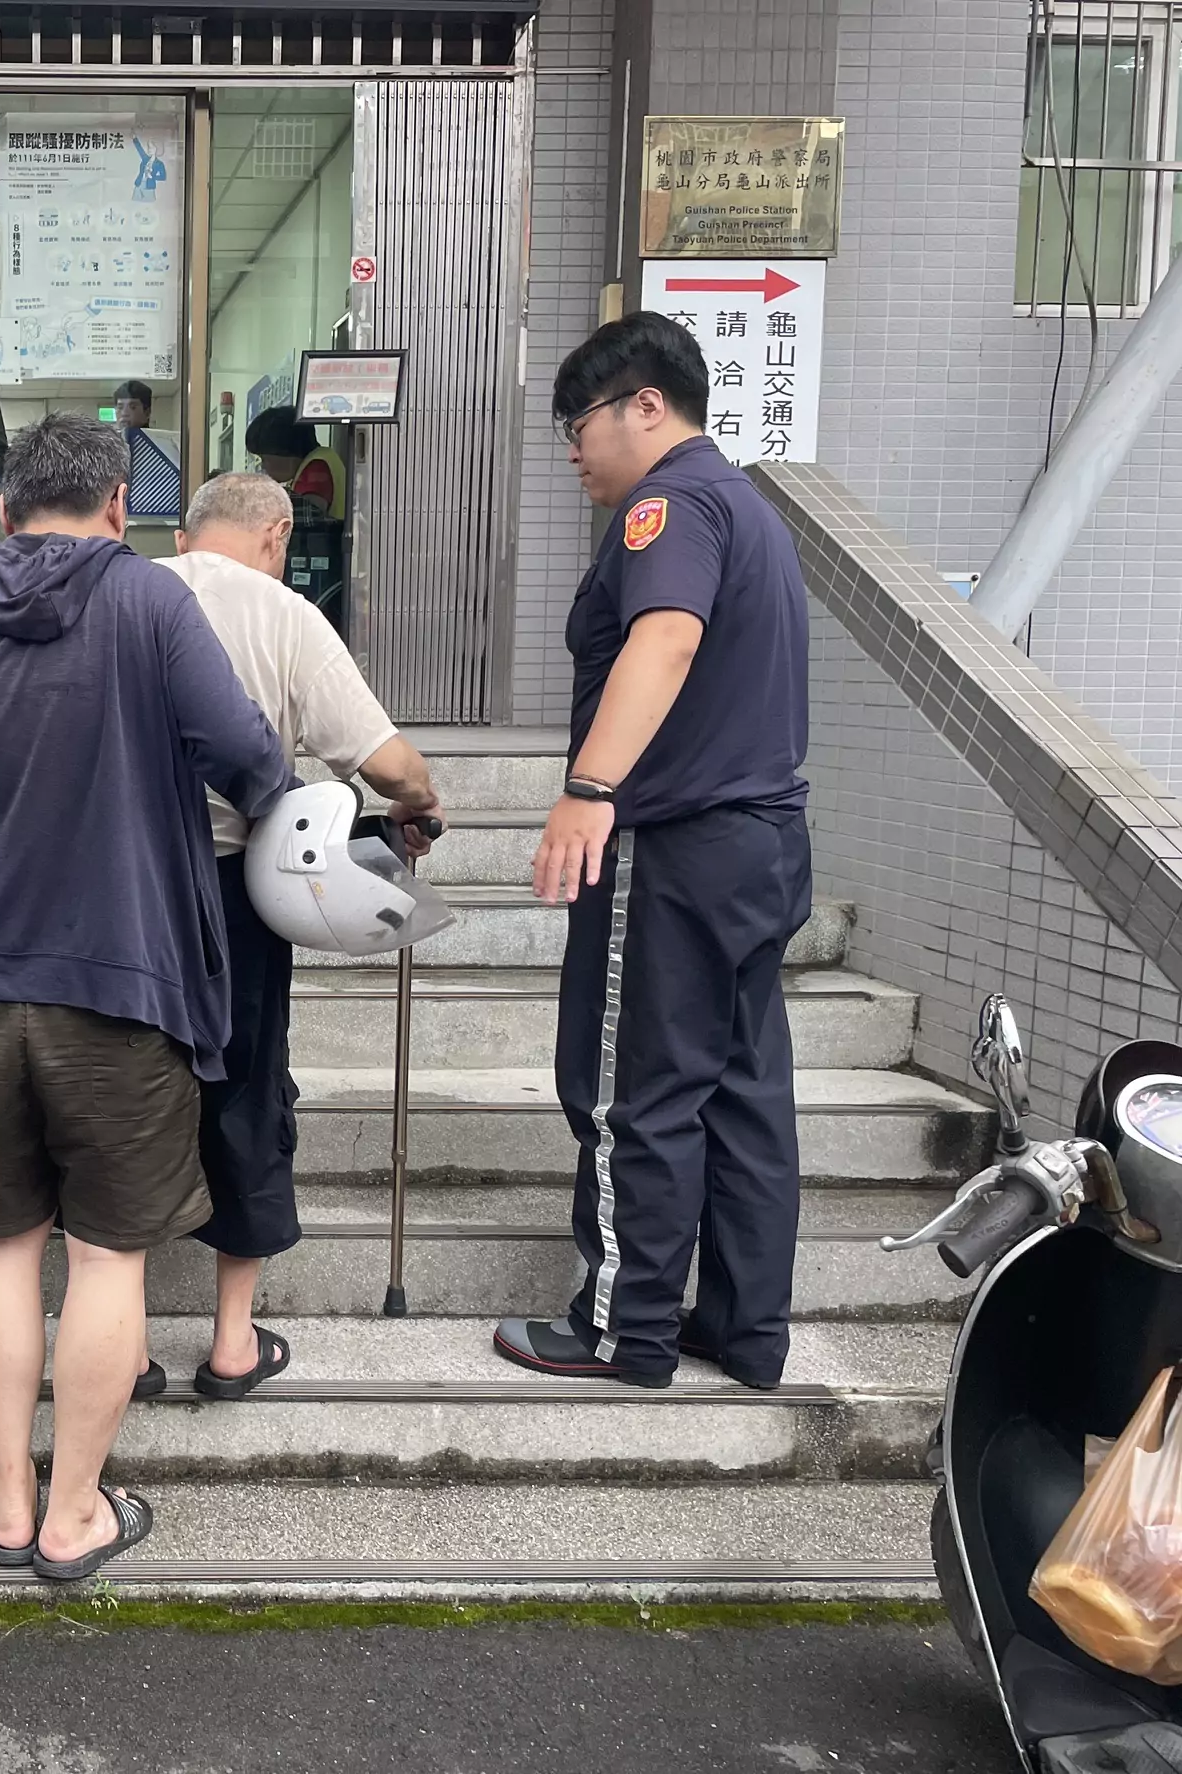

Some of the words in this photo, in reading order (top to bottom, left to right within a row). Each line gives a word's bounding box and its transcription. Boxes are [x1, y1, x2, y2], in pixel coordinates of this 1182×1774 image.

[8, 132, 124, 150] 跟蹤騷擾防制法
[655, 149, 831, 167] 桃園市政府警察局
[656, 173, 831, 191] 龜山分局龜山派出所
[685, 206, 725, 215] Guishan
[729, 206, 759, 215] Police
[763, 206, 798, 215] Station
[698, 220, 739, 229] Guishan
[673, 235, 714, 245] Taoyuan
[717, 235, 747, 243] Police
[750, 235, 808, 245] Department
[711, 311, 747, 467] 請洽右
[761, 311, 797, 463] 龜山交通分
